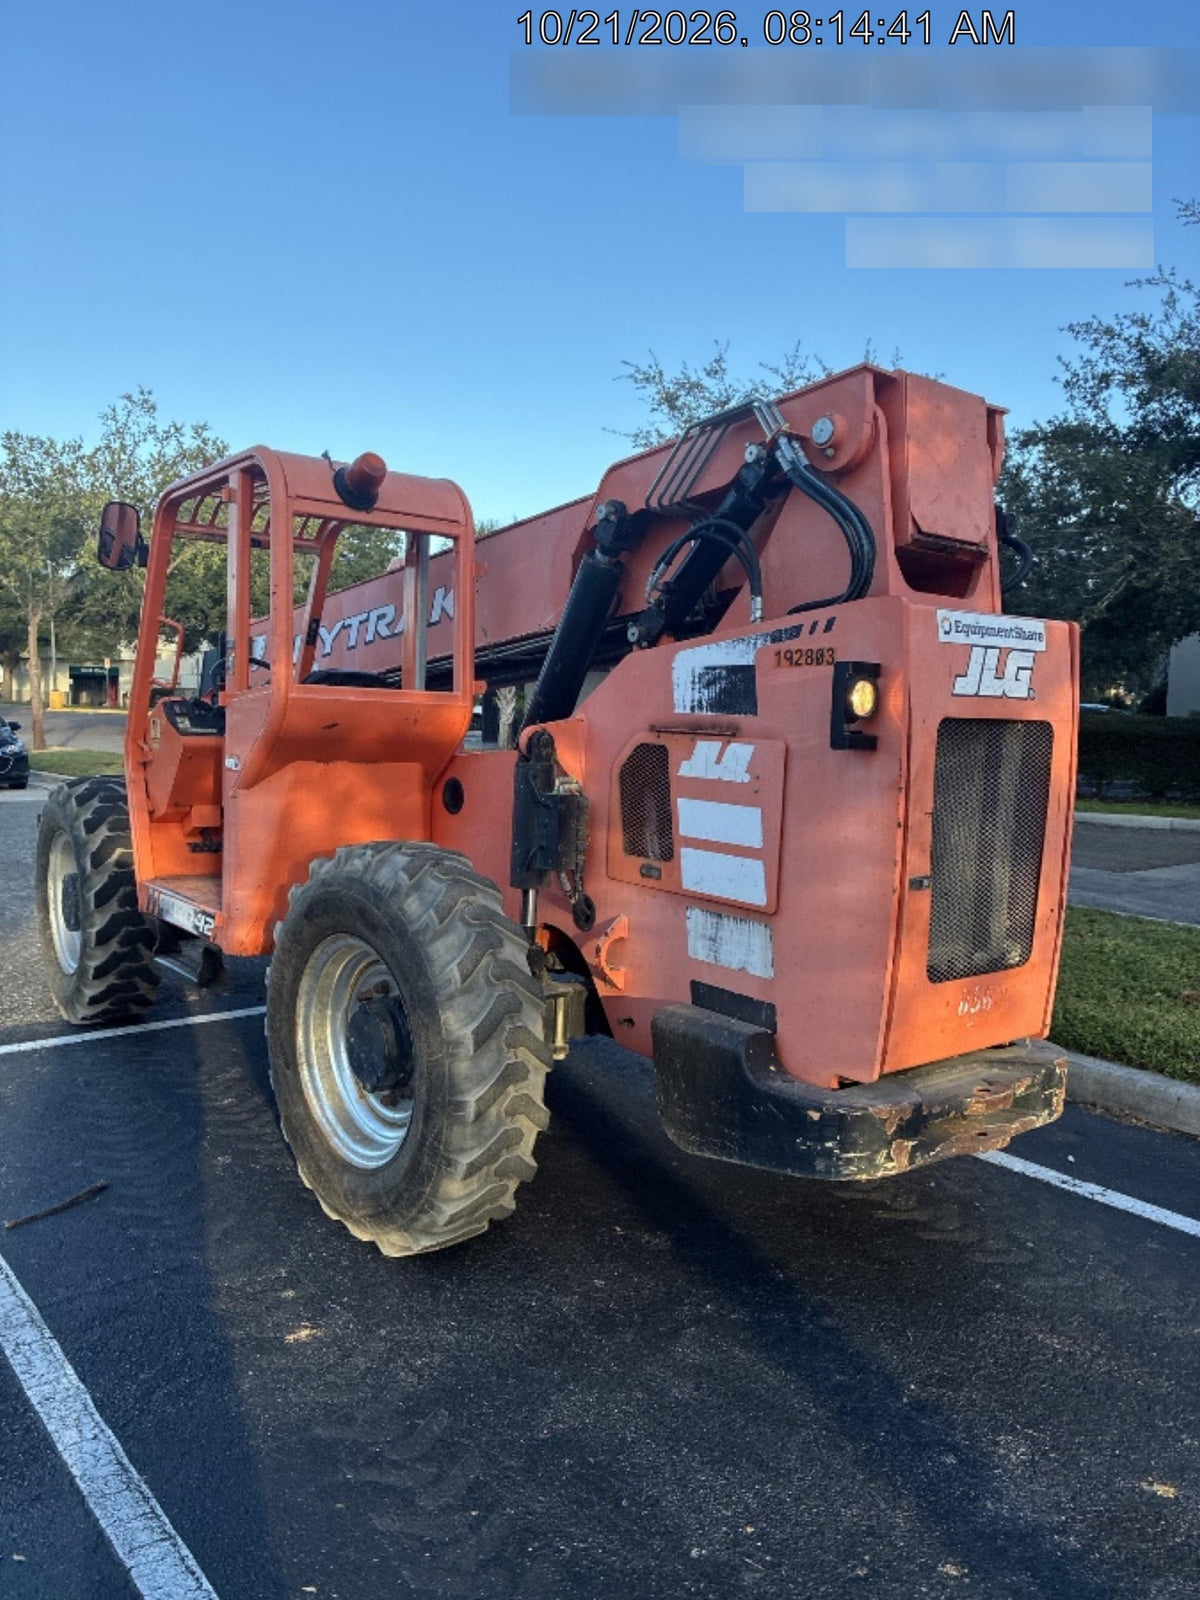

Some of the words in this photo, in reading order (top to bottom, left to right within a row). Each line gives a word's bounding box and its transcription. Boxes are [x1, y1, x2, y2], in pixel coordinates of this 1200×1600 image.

[954, 619, 1044, 643] EquipmentShare
[774, 648, 836, 668] 192803
[951, 645, 1035, 700] JLG
